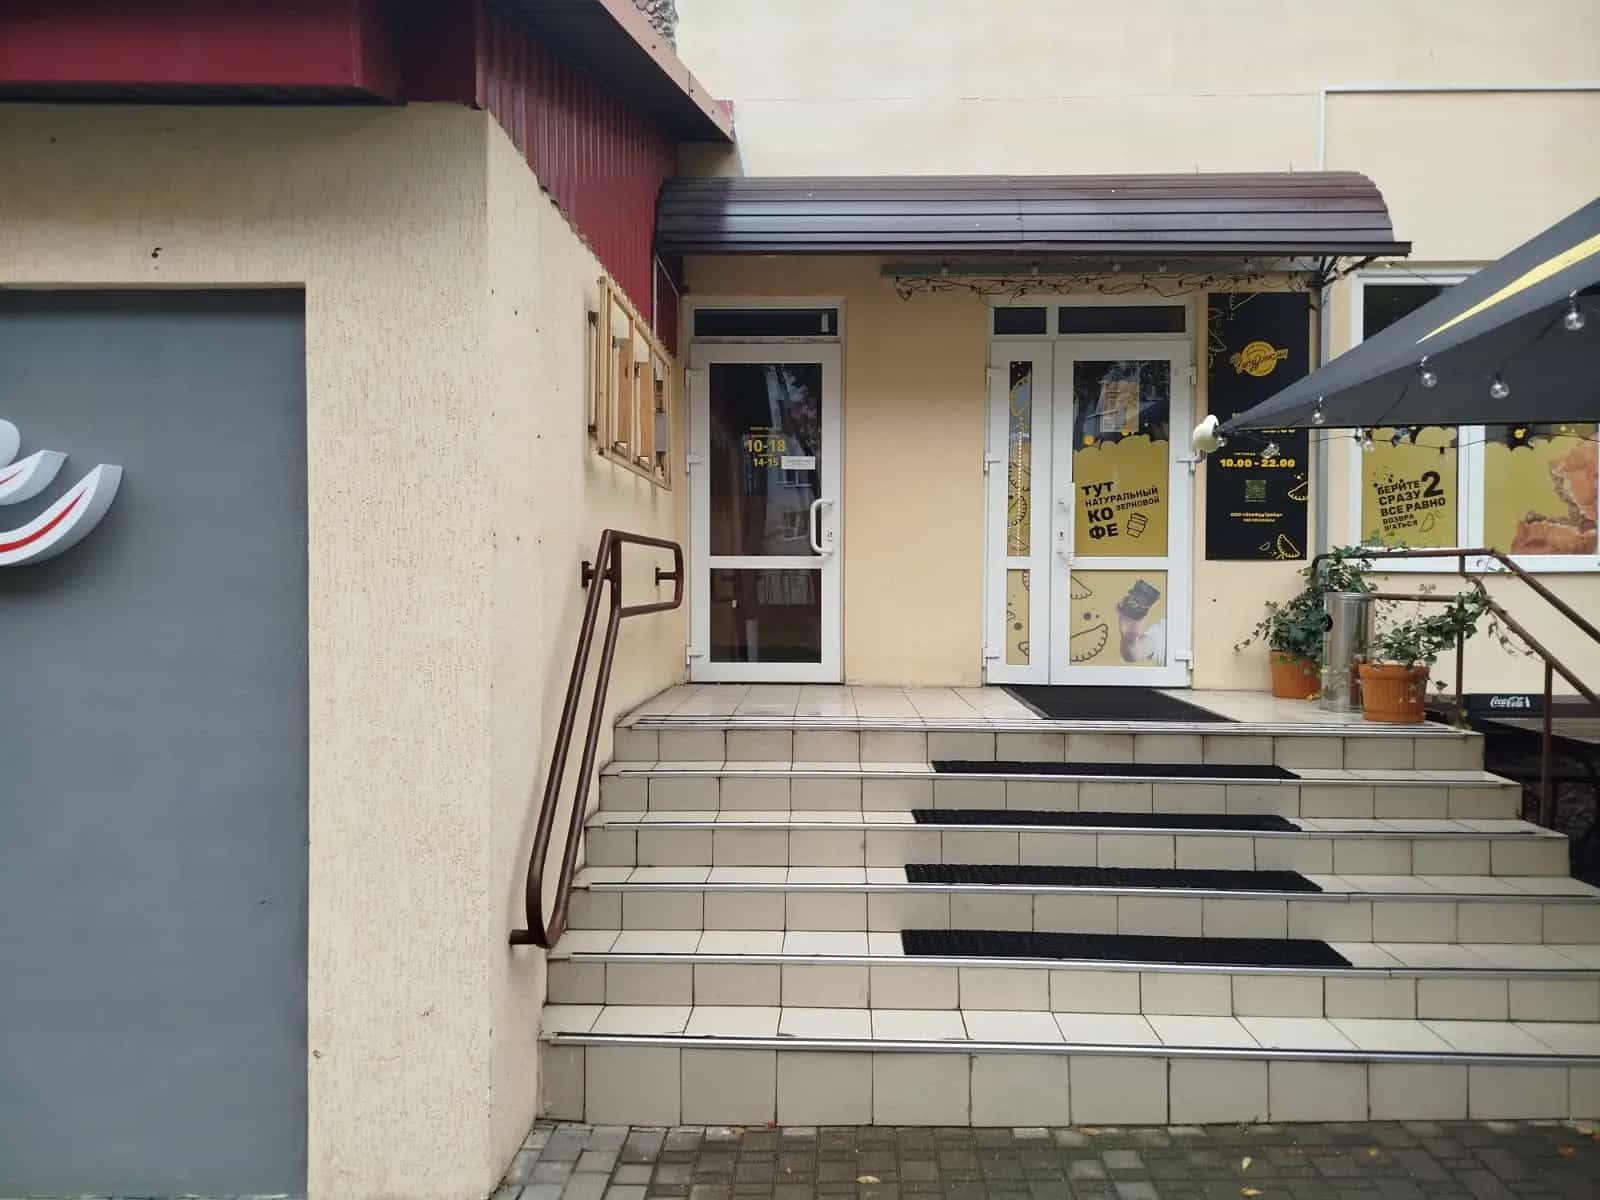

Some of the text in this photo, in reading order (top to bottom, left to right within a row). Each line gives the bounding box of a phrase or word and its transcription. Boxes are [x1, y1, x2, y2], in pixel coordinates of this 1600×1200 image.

[745, 439, 785, 453] 10-18
[1220, 458, 1253, 468] 10.00
[1260, 458, 1296, 468] 22.00
[1081, 481, 1114, 497] ТУТ
[1377, 470, 1444, 498] БЕРИТЕ 2
[1085, 484, 1159, 507] НАТУРАЛЬНЫЙ
[1116, 495, 1160, 511] ЗЕРНОВОЙ
[1378, 489, 1420, 506] СРАЗУ
[1087, 506, 1114, 523] КО
[1380, 497, 1446, 517] ВСЕ РАВНО
[1089, 523, 1119, 539] ФЕ
[1489, 696, 1524, 708] Coca-Cola
